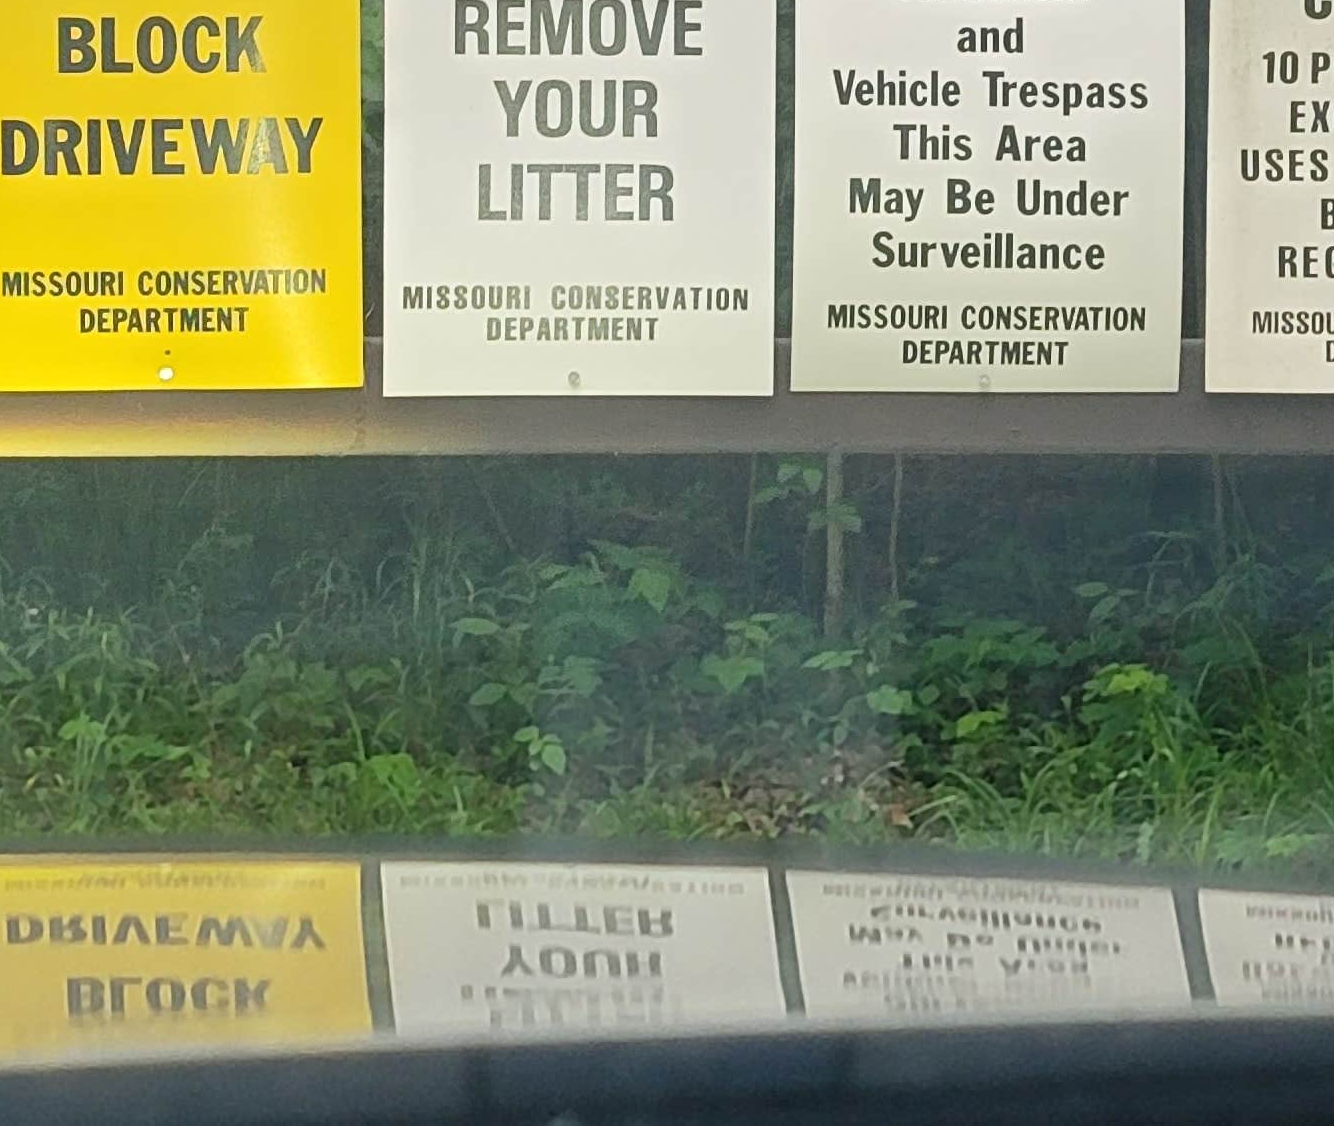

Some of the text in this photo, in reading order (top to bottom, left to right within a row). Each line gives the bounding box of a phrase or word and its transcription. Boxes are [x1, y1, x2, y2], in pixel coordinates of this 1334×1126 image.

[57, 15, 264, 74] BLOCK
[956, 16, 1024, 54] and
[1262, 50, 1299, 85] 10
[492, 79, 658, 139] YOUR
[832, 68, 1149, 117] Vehicle Trespass
[0, 117, 324, 176] DRIVEWAY
[892, 123, 1086, 163] This Area
[1240, 148, 1329, 183] USES
[477, 163, 675, 222] LITTER
[849, 177, 1130, 223] May Be Under
[871, 230, 1106, 271] Surveillance
[1, 268, 326, 297] MISSOURI CONSERVATION
[402, 284, 749, 312] MISSOURI CONSERVATION
[79, 306, 250, 334] DEPARTMENT
[486, 316, 660, 342] DEPARTMENT
[827, 304, 1146, 332] MISSOURI CONSERVATION
[902, 339, 1070, 366] DEPARTMENT
